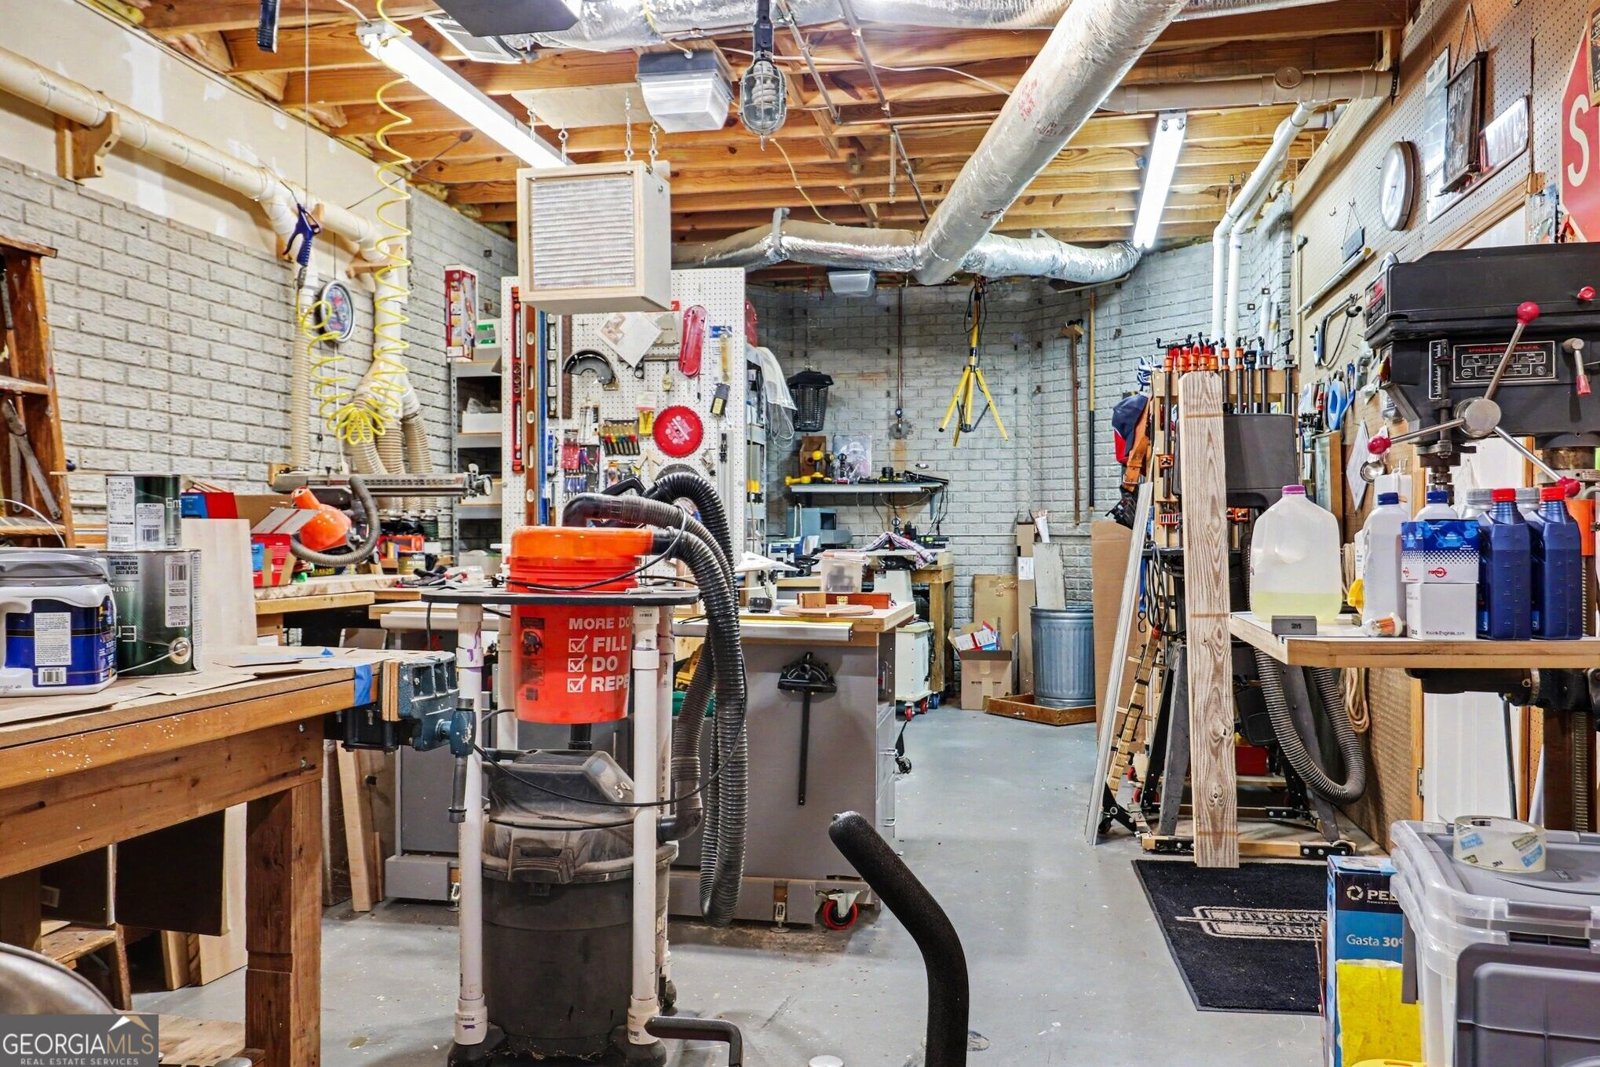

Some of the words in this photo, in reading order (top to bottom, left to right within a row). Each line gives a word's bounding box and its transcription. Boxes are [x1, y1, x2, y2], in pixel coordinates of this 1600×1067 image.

[568, 617, 614, 630] MORE
[592, 636, 627, 653] FILL
[591, 655, 618, 673] DO
[1346, 934, 1380, 946] Gasta
